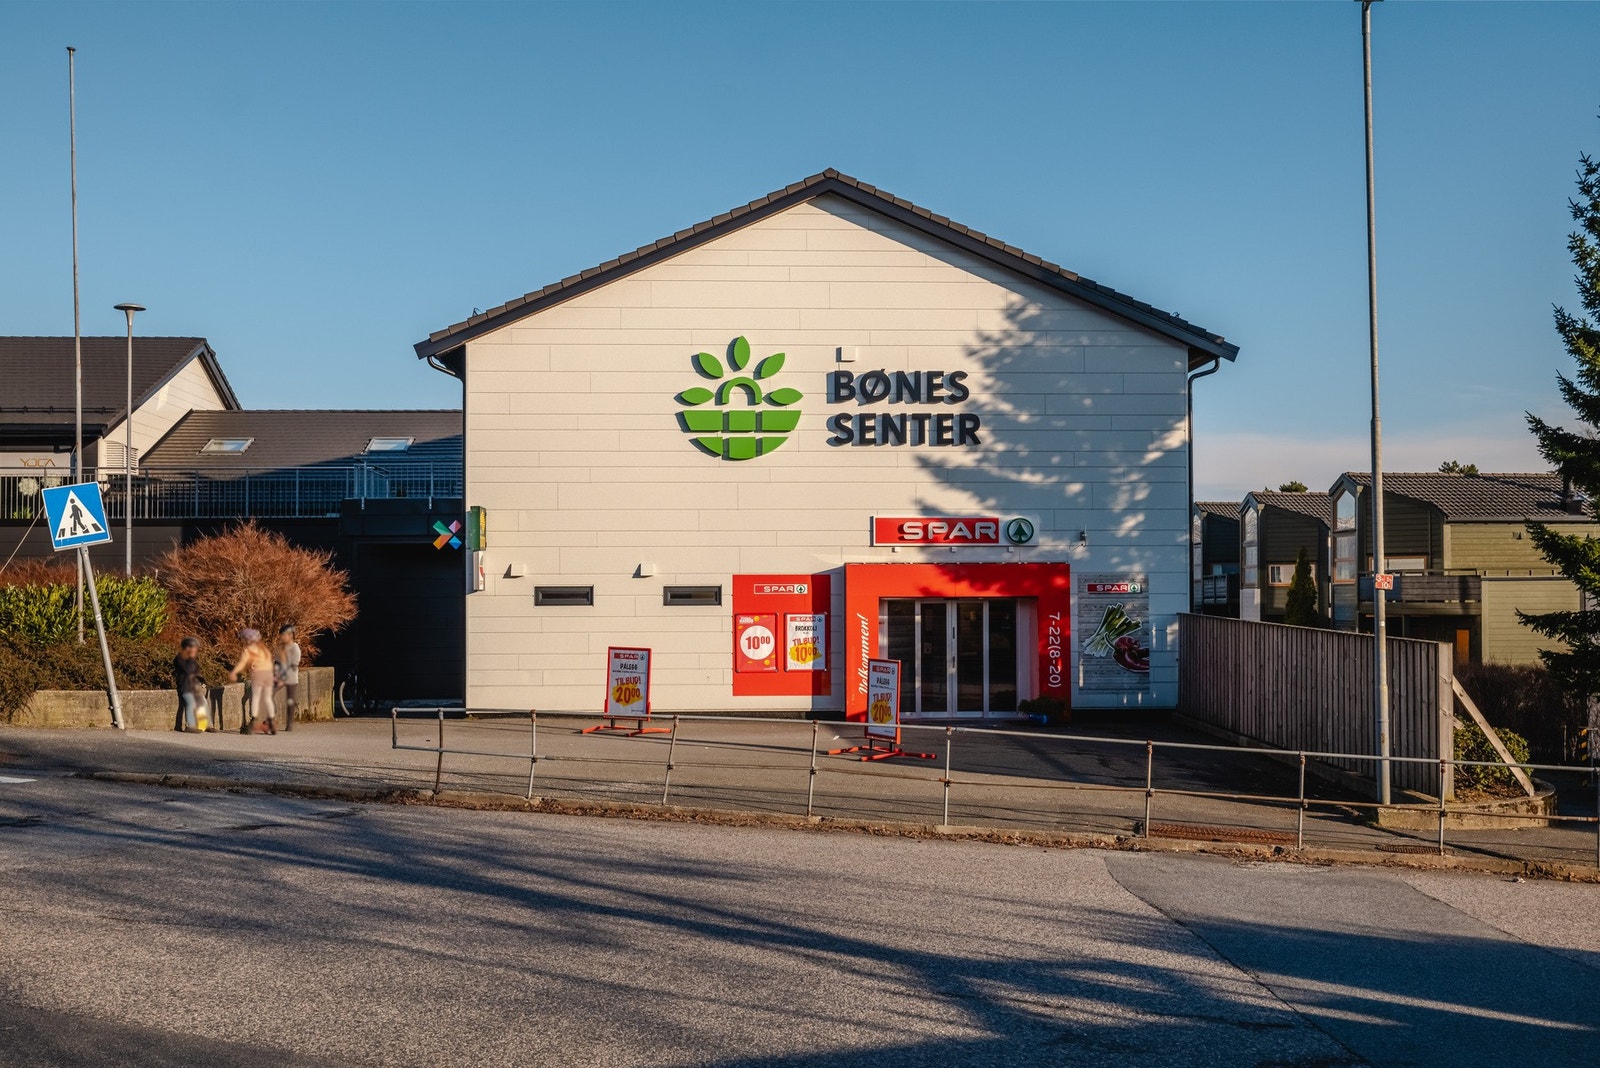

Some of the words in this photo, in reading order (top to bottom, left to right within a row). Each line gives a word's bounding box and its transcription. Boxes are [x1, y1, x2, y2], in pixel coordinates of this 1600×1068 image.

[833, 369, 969, 404] BØNES
[833, 412, 981, 445] SENTER
[903, 521, 996, 540] SPAR
[763, 585, 794, 593] SPAR
[1096, 584, 1128, 592] SPAR
[1047, 611, 1062, 688] 7-22(8-20)
[615, 676, 641, 686] TILBUD!
